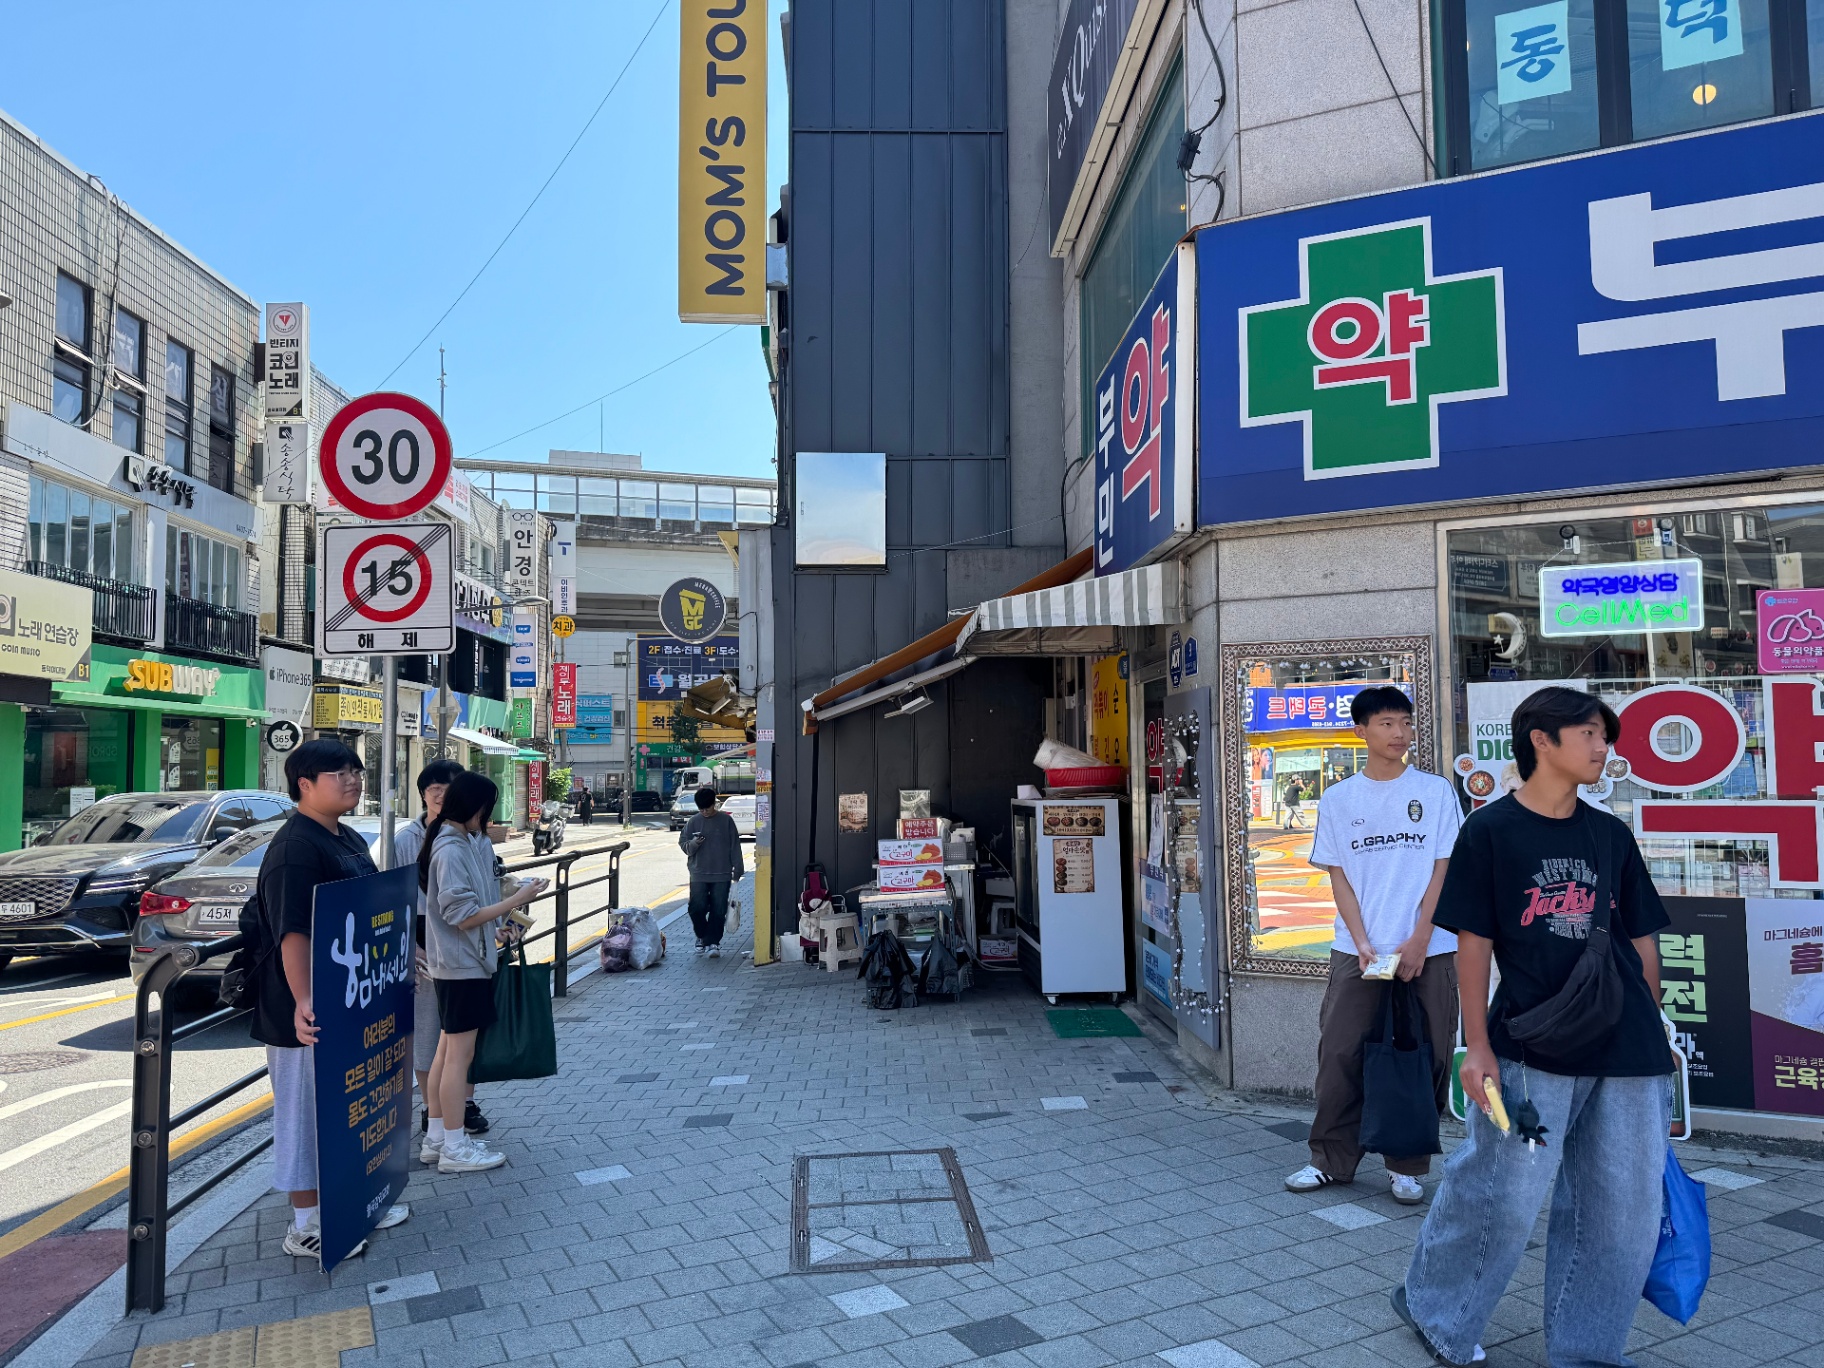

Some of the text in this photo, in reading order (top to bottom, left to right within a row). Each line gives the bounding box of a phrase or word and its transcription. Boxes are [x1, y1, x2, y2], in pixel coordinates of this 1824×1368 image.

[1500, 24, 1565, 84] 동
[700, 116, 747, 296] MOM'S
[270, 338, 299, 349] 빈티지
[1307, 287, 1431, 407] 약
[269, 372, 299, 389] 노래
[1121, 302, 1169, 522] 약
[351, 428, 420, 485] 30
[1099, 373, 1115, 569] 부민
[514, 530, 534, 577] 안경
[361, 559, 414, 598] 15
[1561, 573, 1679, 596] 약국영양상담
[1555, 595, 1689, 627] CellMed
[17, 617, 79, 647] 노래 연습장
[358, 632, 418, 649] 해 제
[553, 620, 574, 633] 치과
[648, 645, 662, 655] 2F
[704, 645, 717, 656] 3F
[78, 663, 89, 678] B1
[123, 658, 221, 696] SUBWAY
[557, 686, 573, 715] 노래
[273, 734, 291, 745] 365
[1476, 723, 1513, 736] KORE
[1351, 832, 1427, 850] C.GRAPHY
[9, 902, 34, 915] 4601
[1764, 925, 1823, 941] 마그네슘에
[363, 1012, 396, 1049] 여러분의
[345, 1036, 406, 1094] 모든 일이 잘 되고
[1774, 1055, 1807, 1067] 마그네슘
[348, 1067, 405, 1129] 몸도 건강하기를
[360, 1105, 397, 1153] 기도합니다
